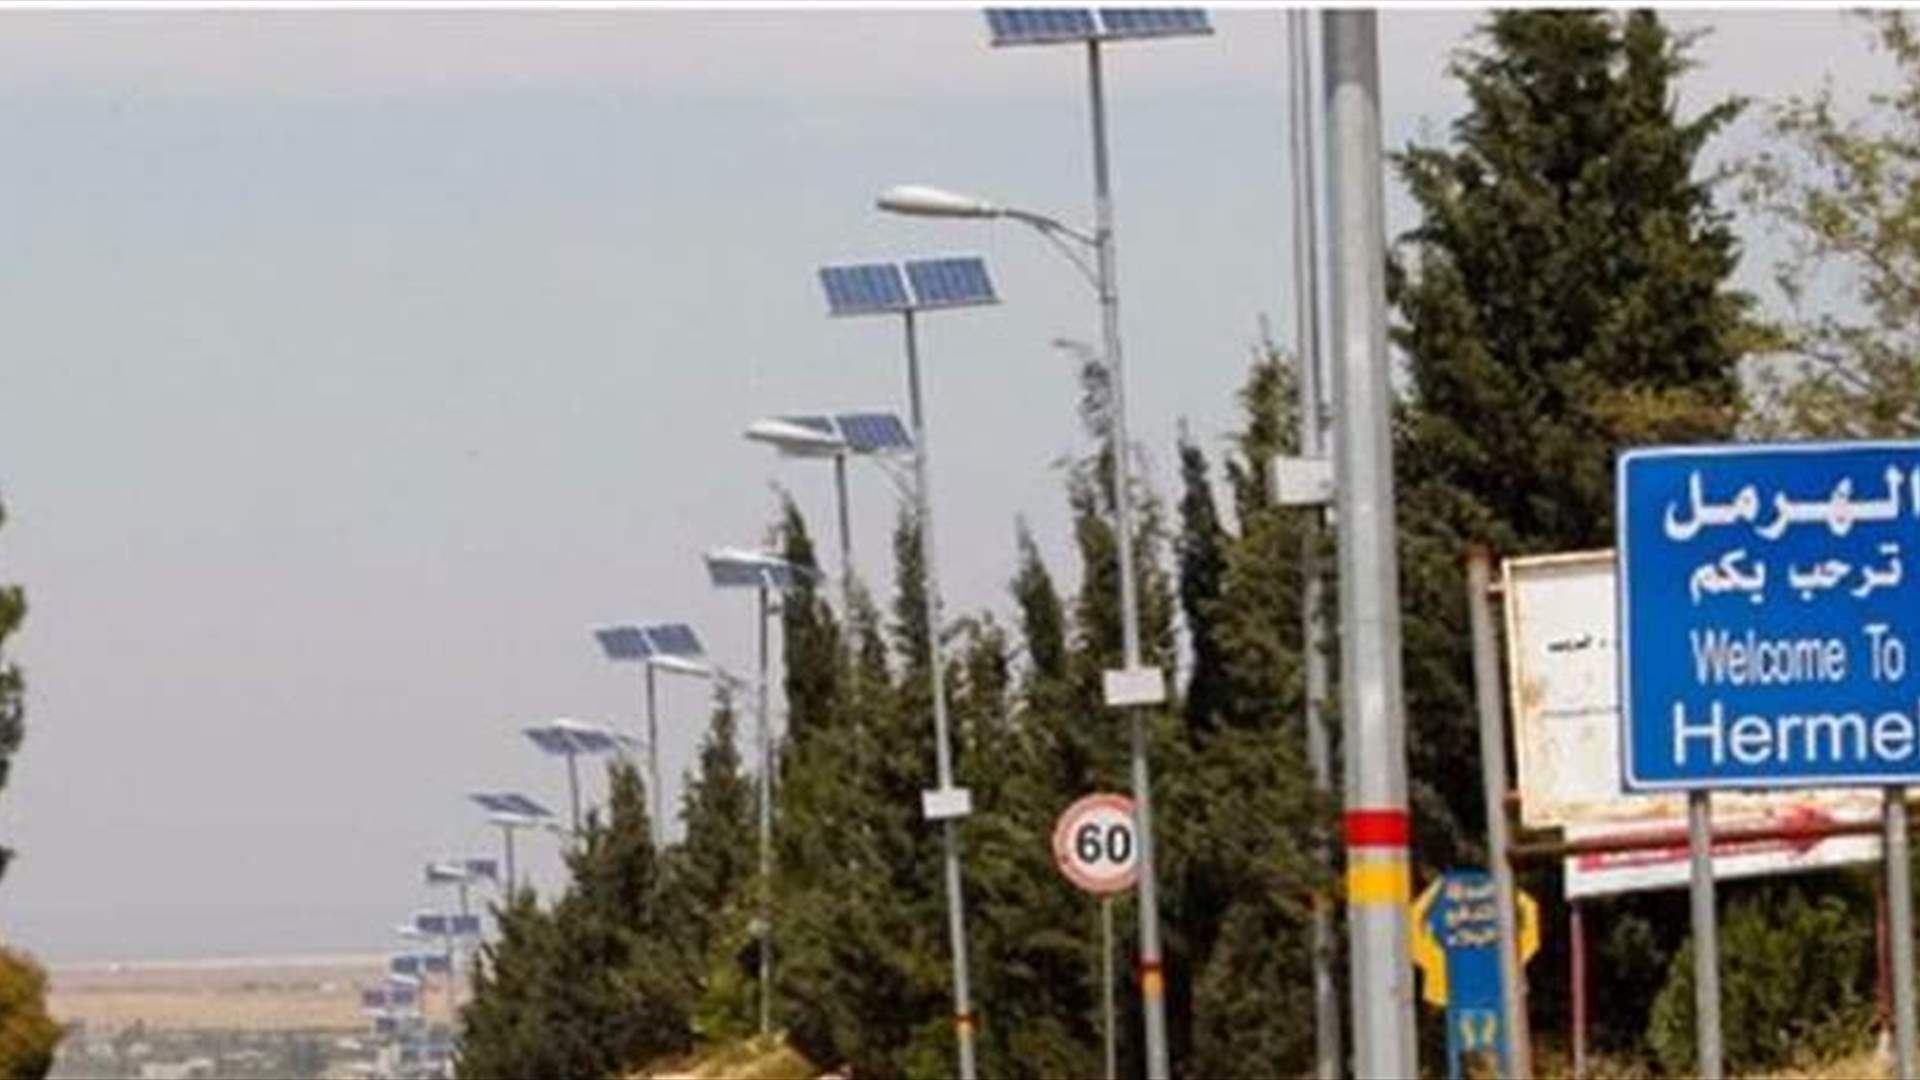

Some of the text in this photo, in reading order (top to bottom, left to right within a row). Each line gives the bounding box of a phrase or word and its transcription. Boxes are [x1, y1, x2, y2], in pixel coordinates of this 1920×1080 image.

[1690, 544, 1901, 605] ترحب بكم
[1690, 623, 1905, 685] Welcome To
[1674, 699, 1920, 766] Herme
[1076, 823, 1131, 865] 60
